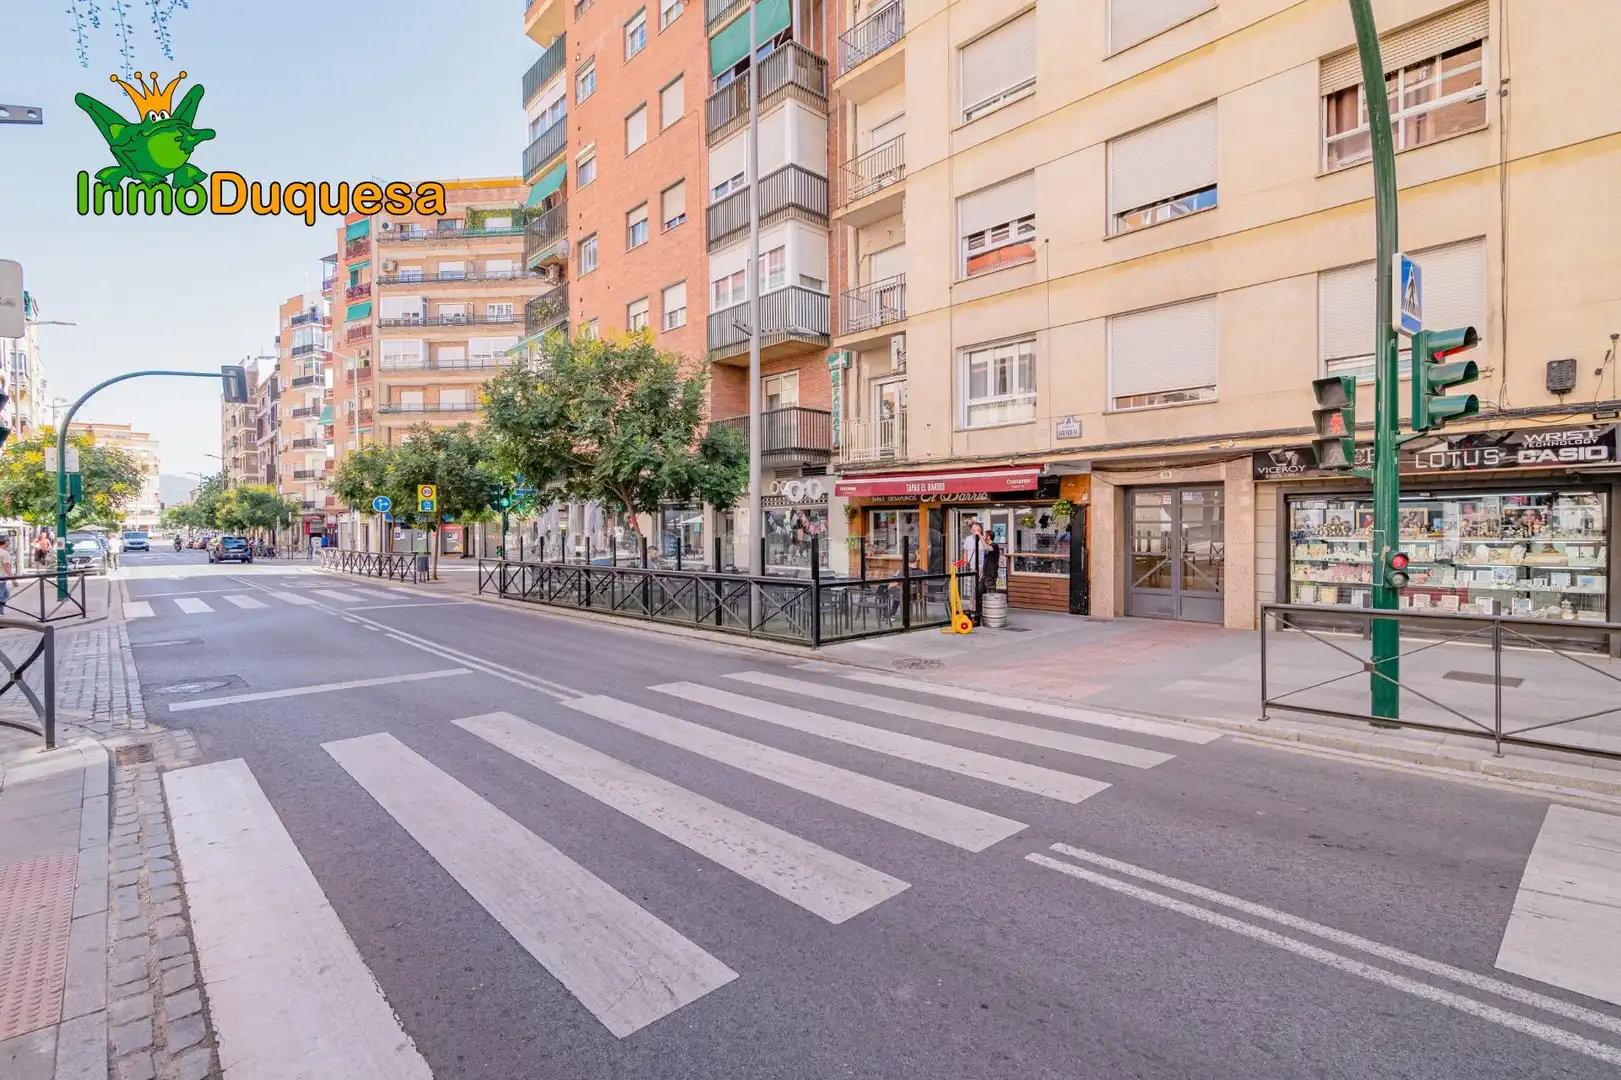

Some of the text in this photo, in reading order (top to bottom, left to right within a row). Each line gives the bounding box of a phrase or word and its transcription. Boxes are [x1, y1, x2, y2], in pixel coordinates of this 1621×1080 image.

[1523, 429, 1600, 442] WRIST
[1522, 438, 1599, 448] TECHNOLOGY
[1415, 449, 1500, 469] LOTUS
[1517, 445, 1608, 463] CASIO
[1258, 464, 1306, 474] VICEROY
[906, 483, 920, 492] TAPAS
[921, 483, 927, 492] EL
